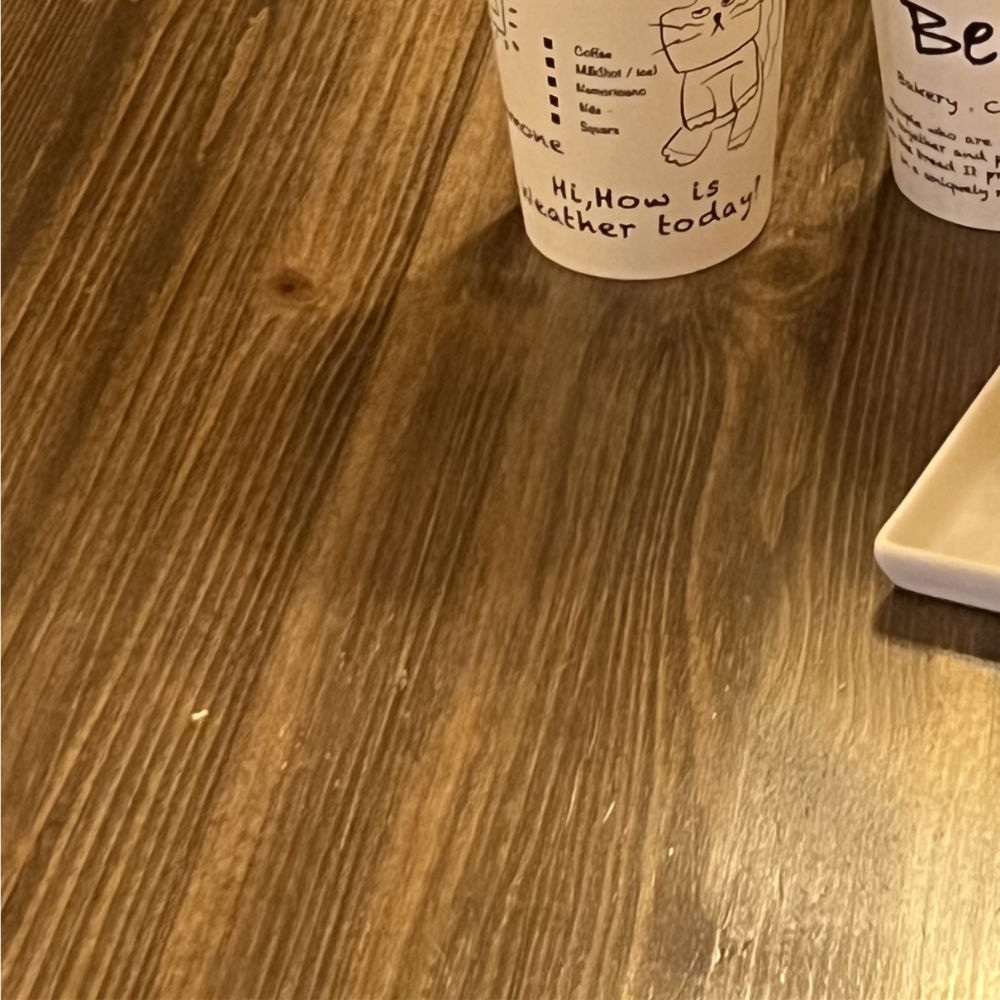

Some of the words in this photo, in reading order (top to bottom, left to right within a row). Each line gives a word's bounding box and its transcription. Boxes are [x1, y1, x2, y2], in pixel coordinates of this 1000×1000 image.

[897, 70, 958, 116] Bakery
[965, 136, 993, 147] are
[953, 150, 987, 162] and
[692, 179, 719, 201] is
[658, 175, 761, 236] today!
